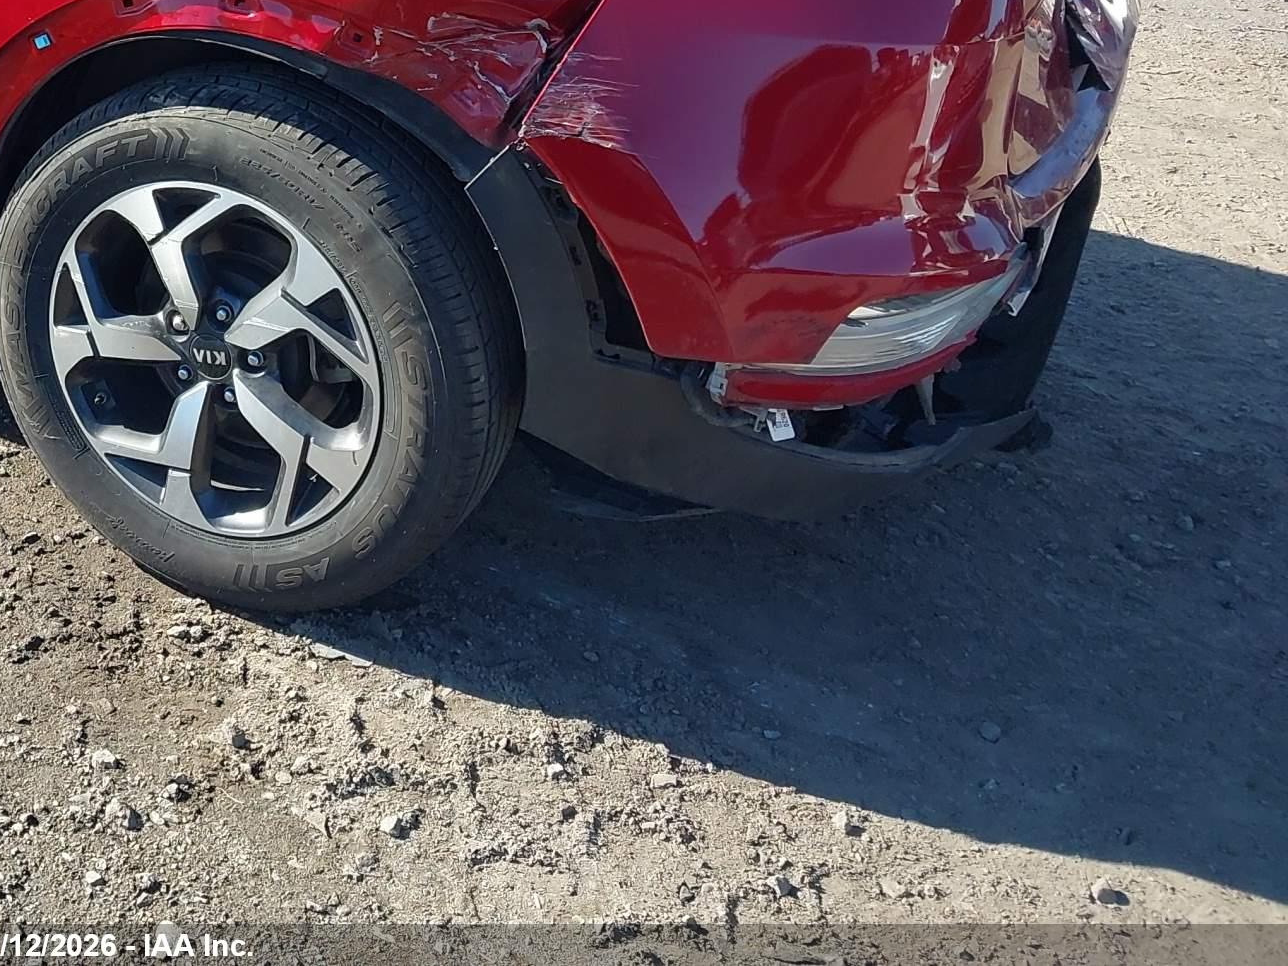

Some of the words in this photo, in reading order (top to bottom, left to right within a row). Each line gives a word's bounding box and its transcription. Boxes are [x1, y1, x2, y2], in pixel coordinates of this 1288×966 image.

[9, 133, 150, 402] MASTERCRAFT
[193, 347, 227, 366] KIA
[351, 348, 429, 559] STRATUS
